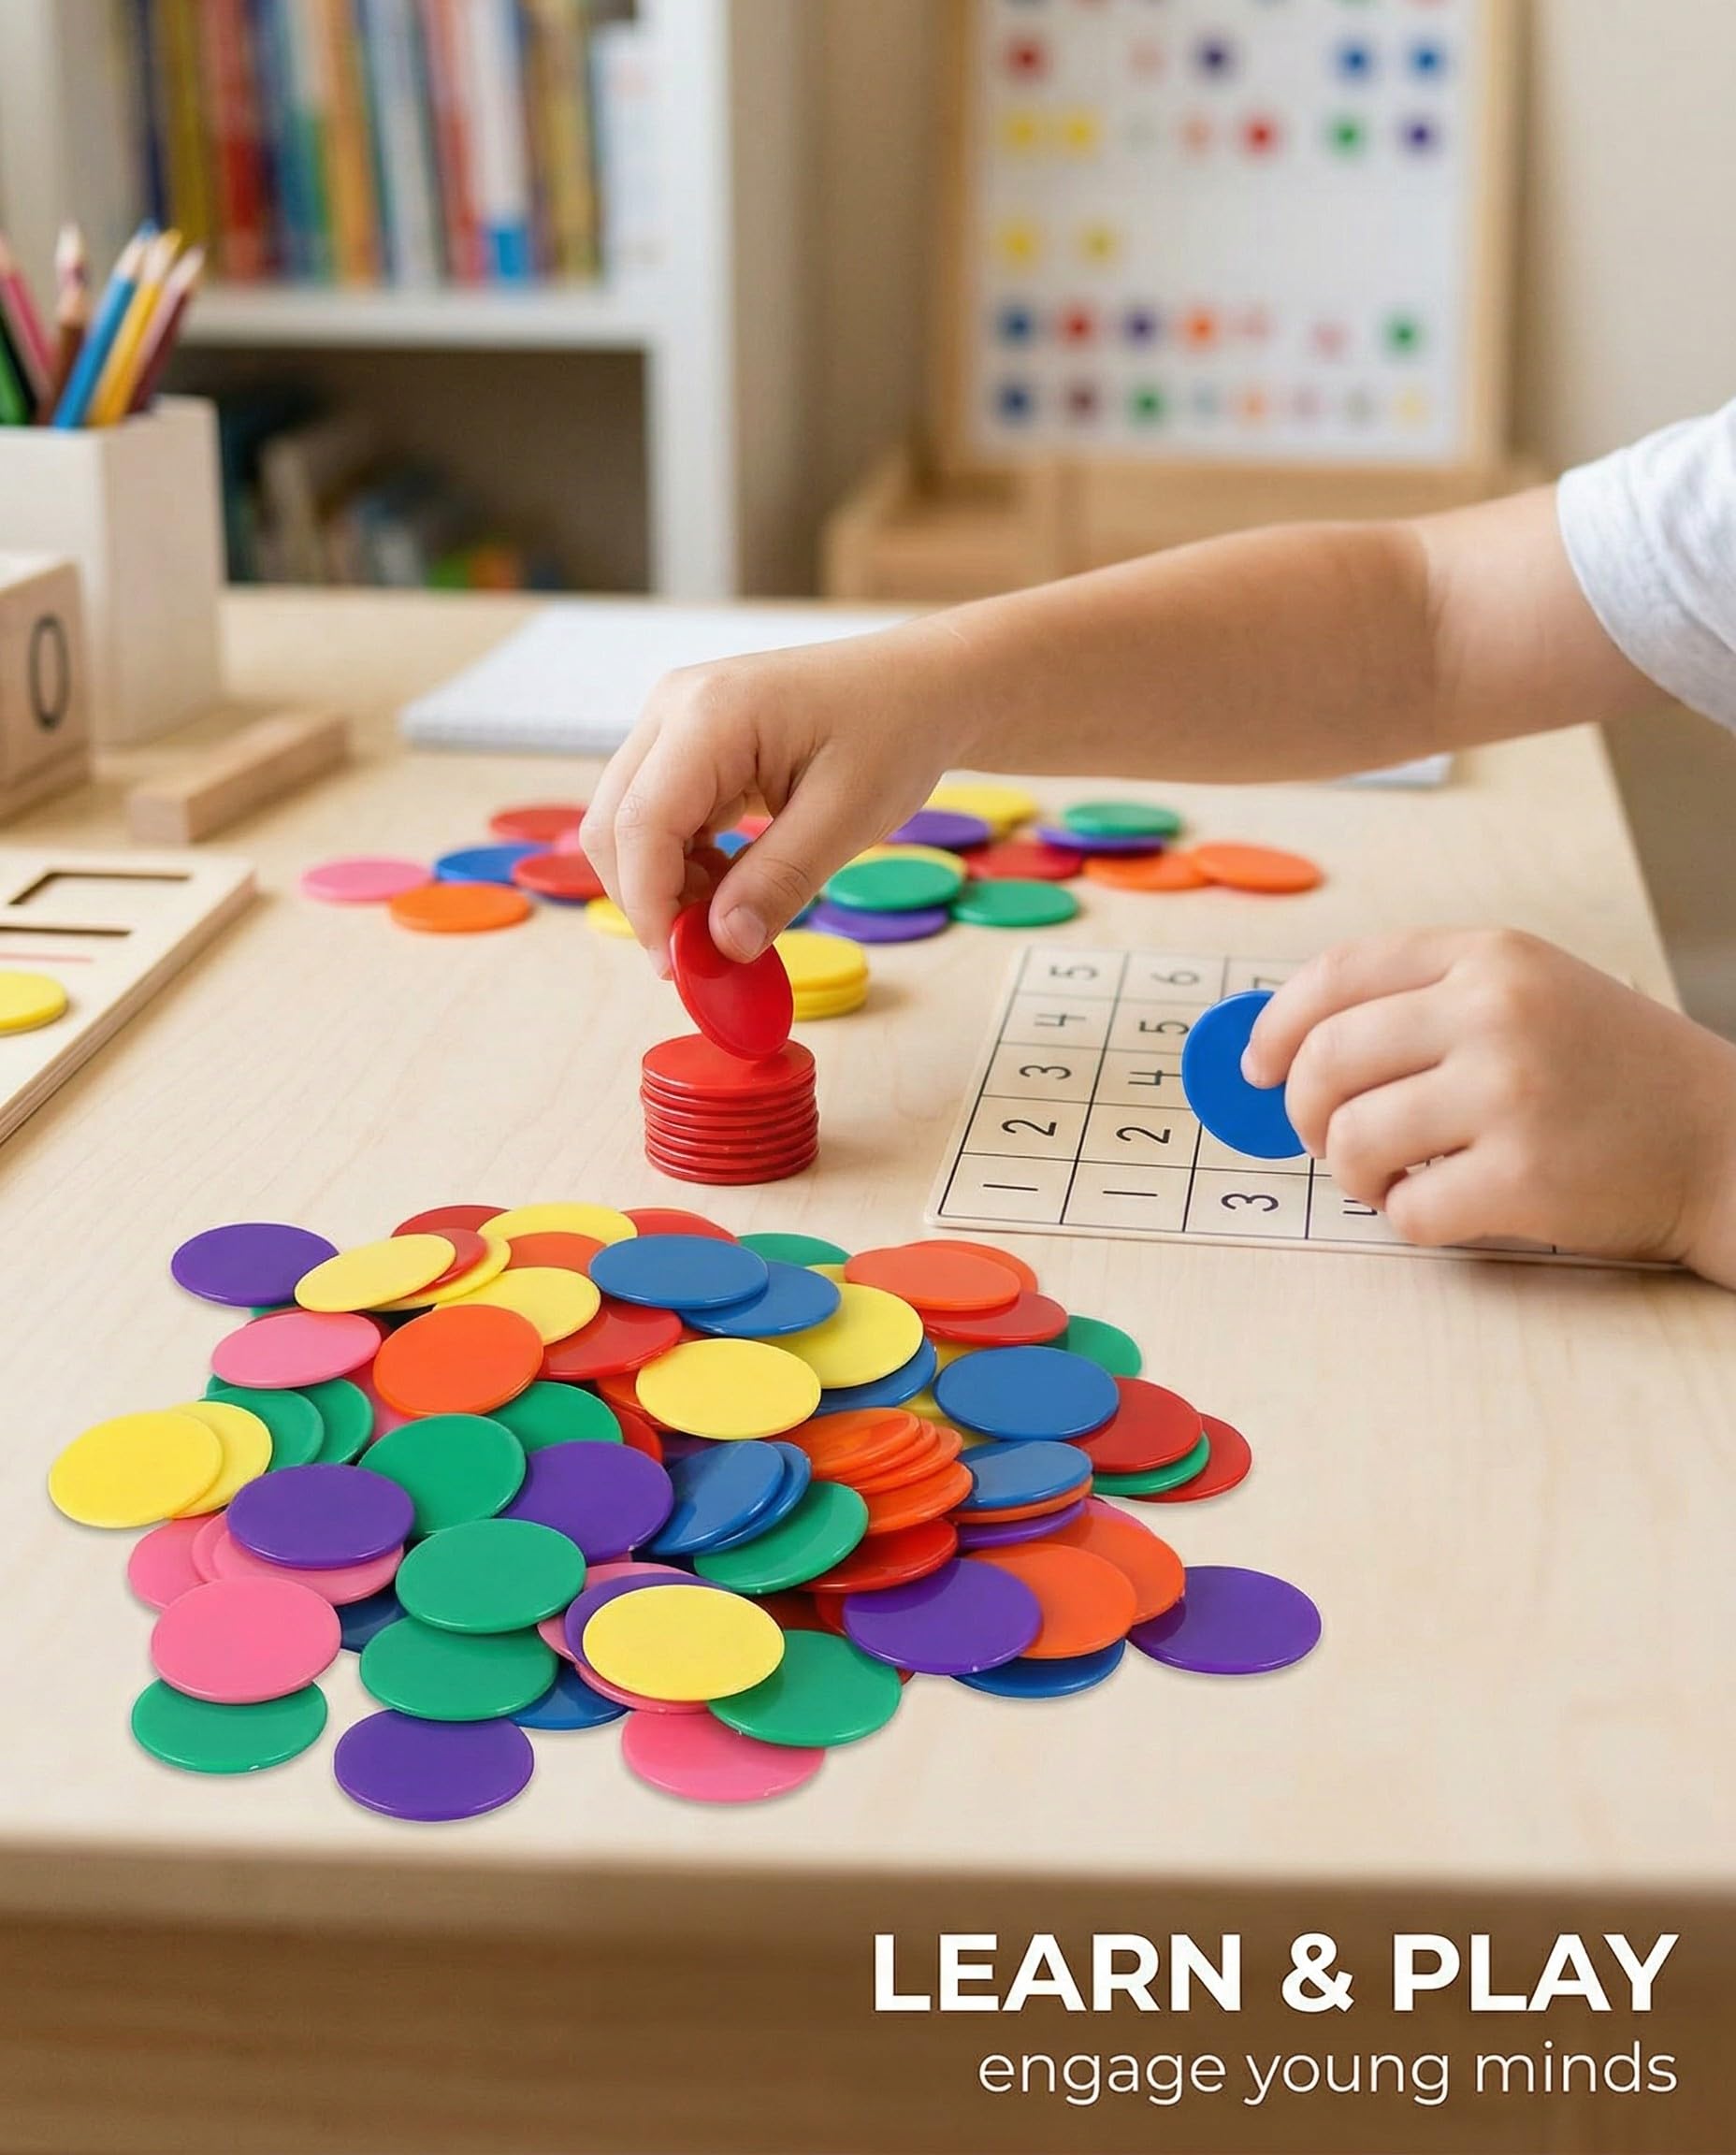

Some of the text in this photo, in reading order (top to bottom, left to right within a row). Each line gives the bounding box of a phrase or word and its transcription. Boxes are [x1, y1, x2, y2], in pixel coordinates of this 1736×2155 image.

[1049, 964, 1099, 980] 5
[1150, 970, 1200, 986] 6
[1034, 1012, 1087, 1028] 4
[1138, 1020, 1190, 1036] 5
[1018, 1064, 1073, 1080] 3
[1127, 1069, 1181, 1087] 4
[1001, 1119, 1058, 1137] 2
[1115, 1126, 1172, 1145] 2
[1220, 1193, 1280, 1213] 3
